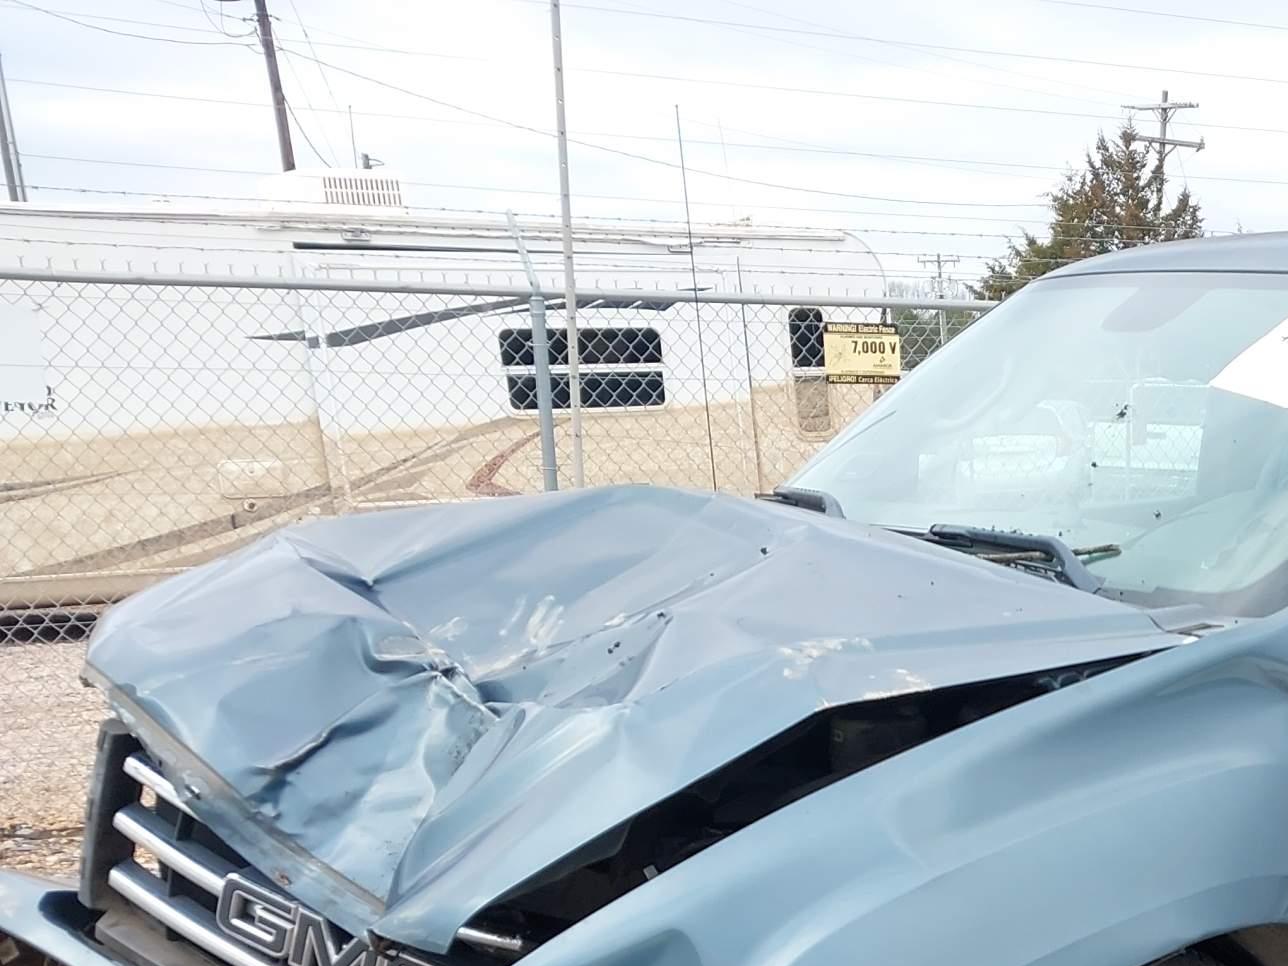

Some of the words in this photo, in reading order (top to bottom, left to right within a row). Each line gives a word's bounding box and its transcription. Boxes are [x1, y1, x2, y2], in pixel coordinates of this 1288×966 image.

[827, 324, 857, 333] WARNING!
[858, 324, 879, 333] Electric
[879, 325, 896, 334] Fence
[852, 340, 886, 356] 7,000
[889, 341, 897, 355] V
